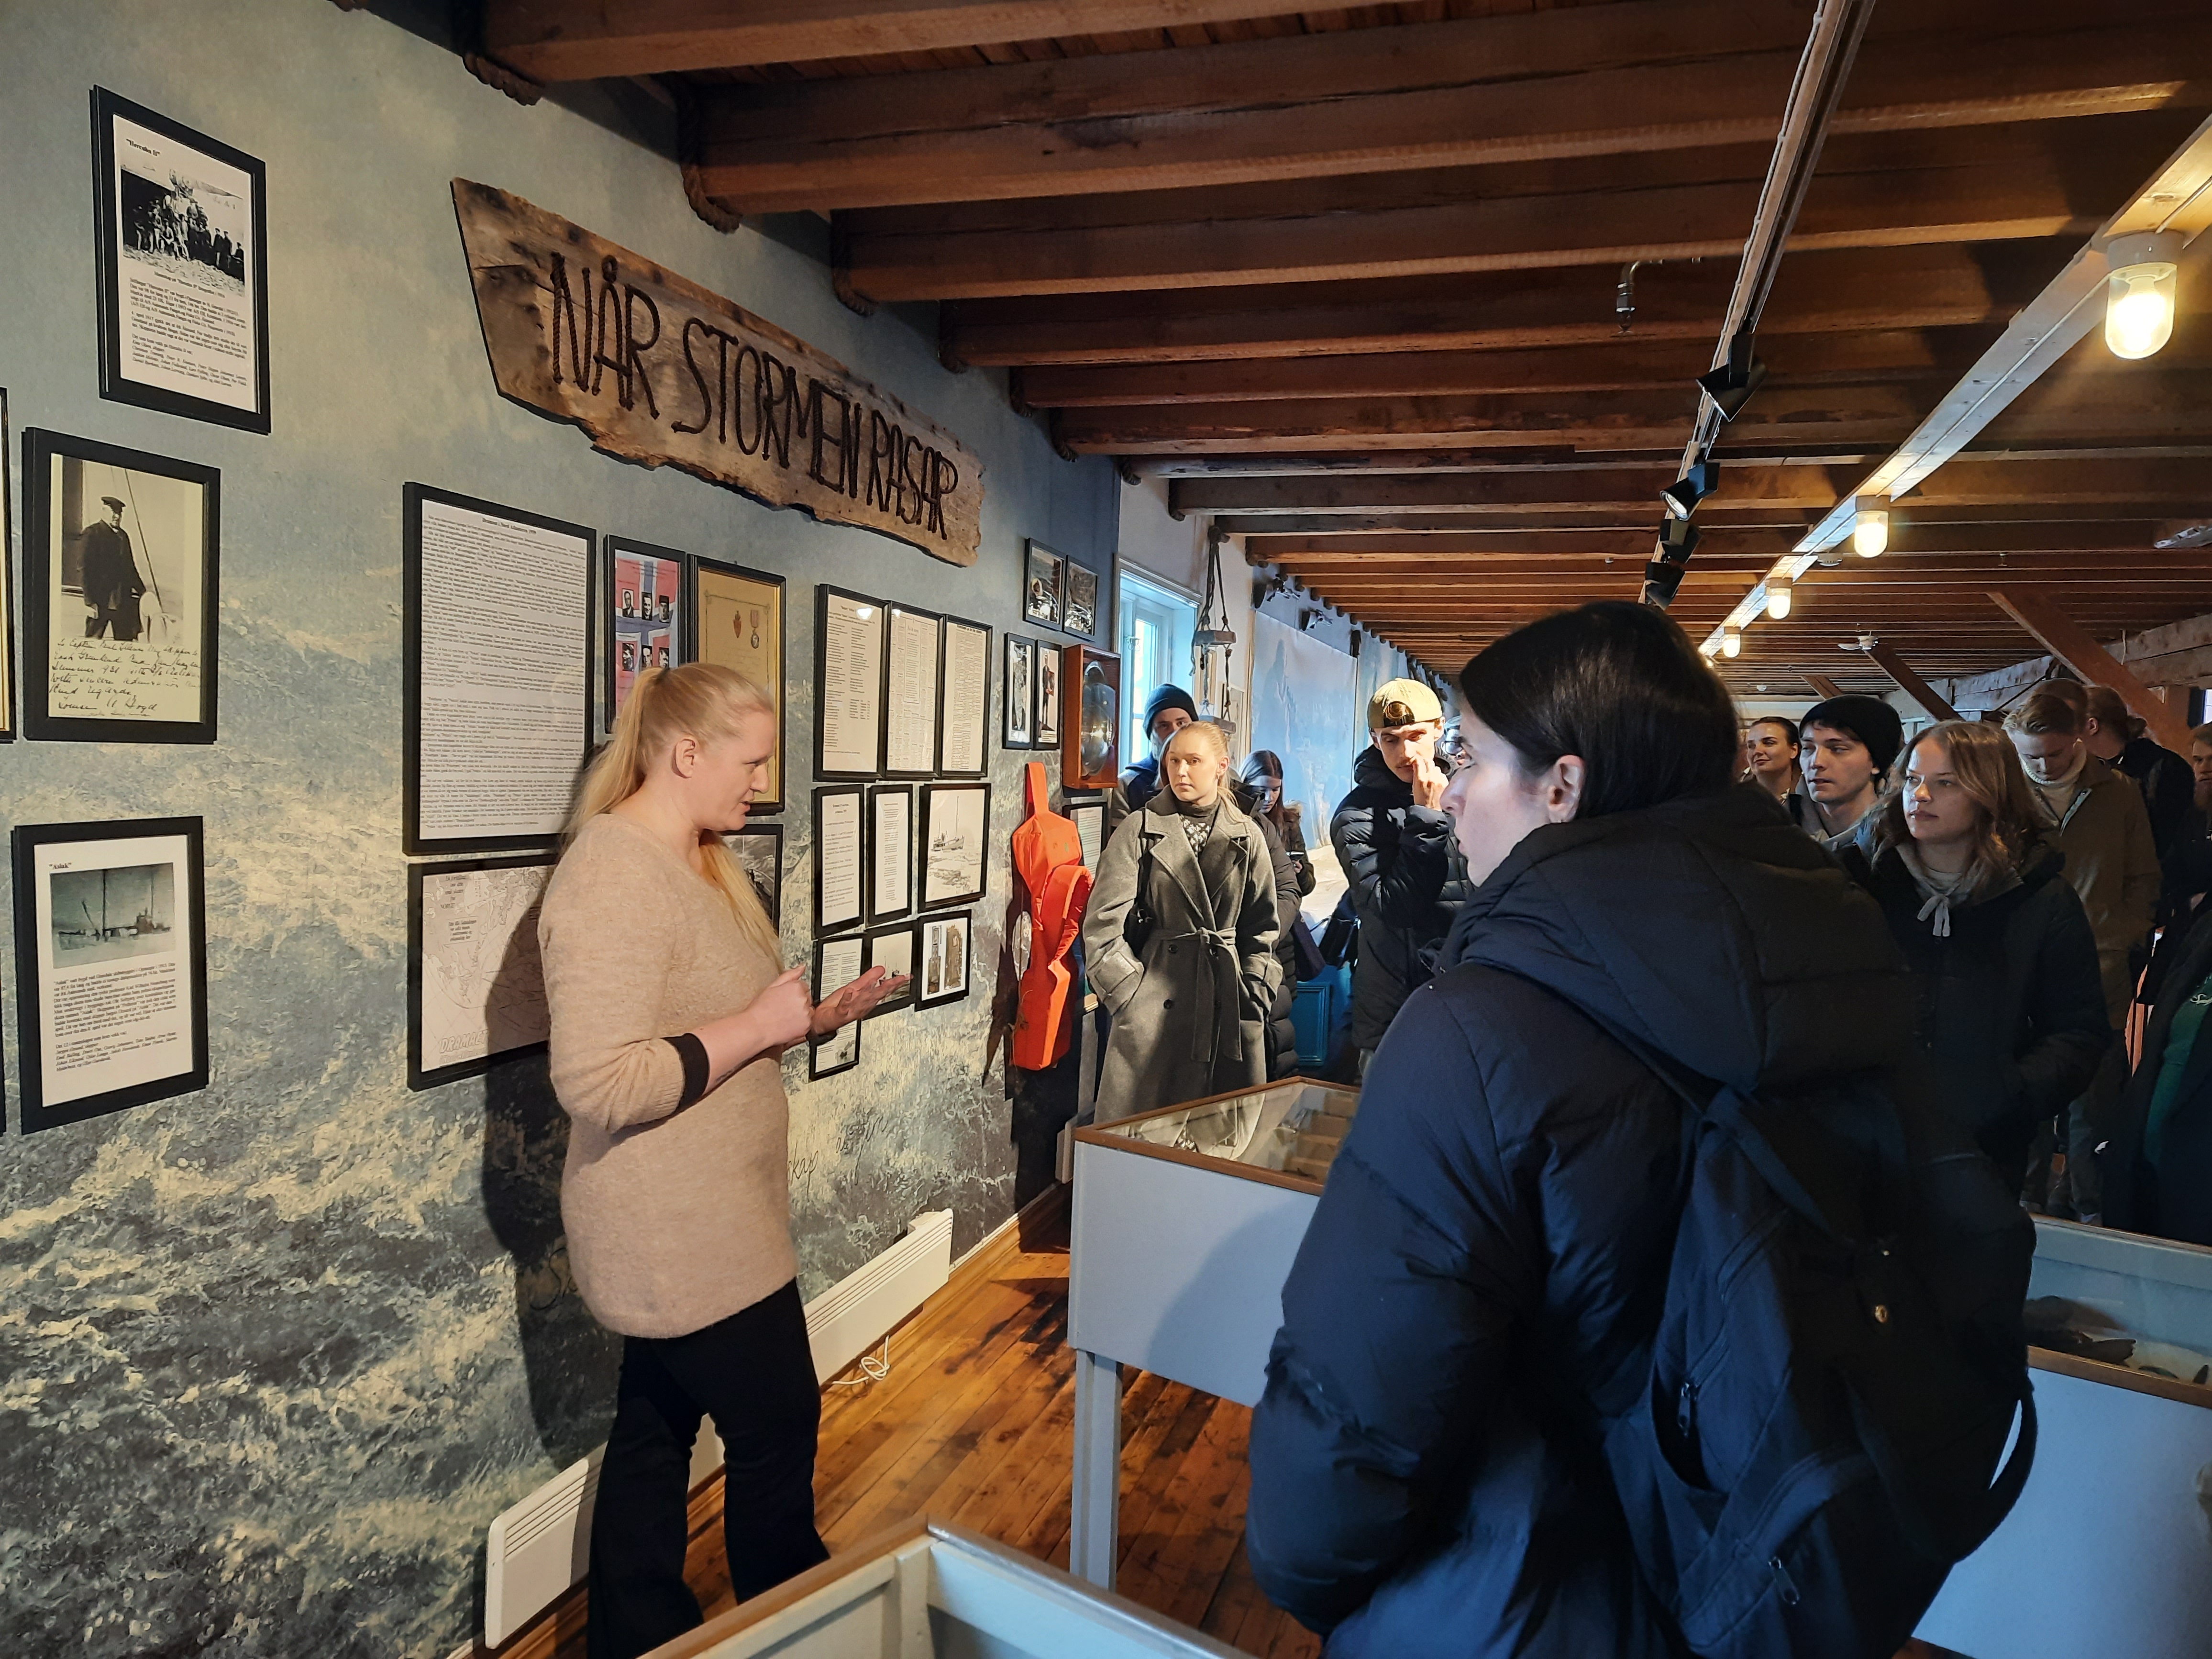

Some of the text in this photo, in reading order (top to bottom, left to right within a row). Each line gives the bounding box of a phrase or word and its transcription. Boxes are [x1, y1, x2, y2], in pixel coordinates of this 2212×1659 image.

[550, 251, 958, 540] NÅR STORMEN RASAR
